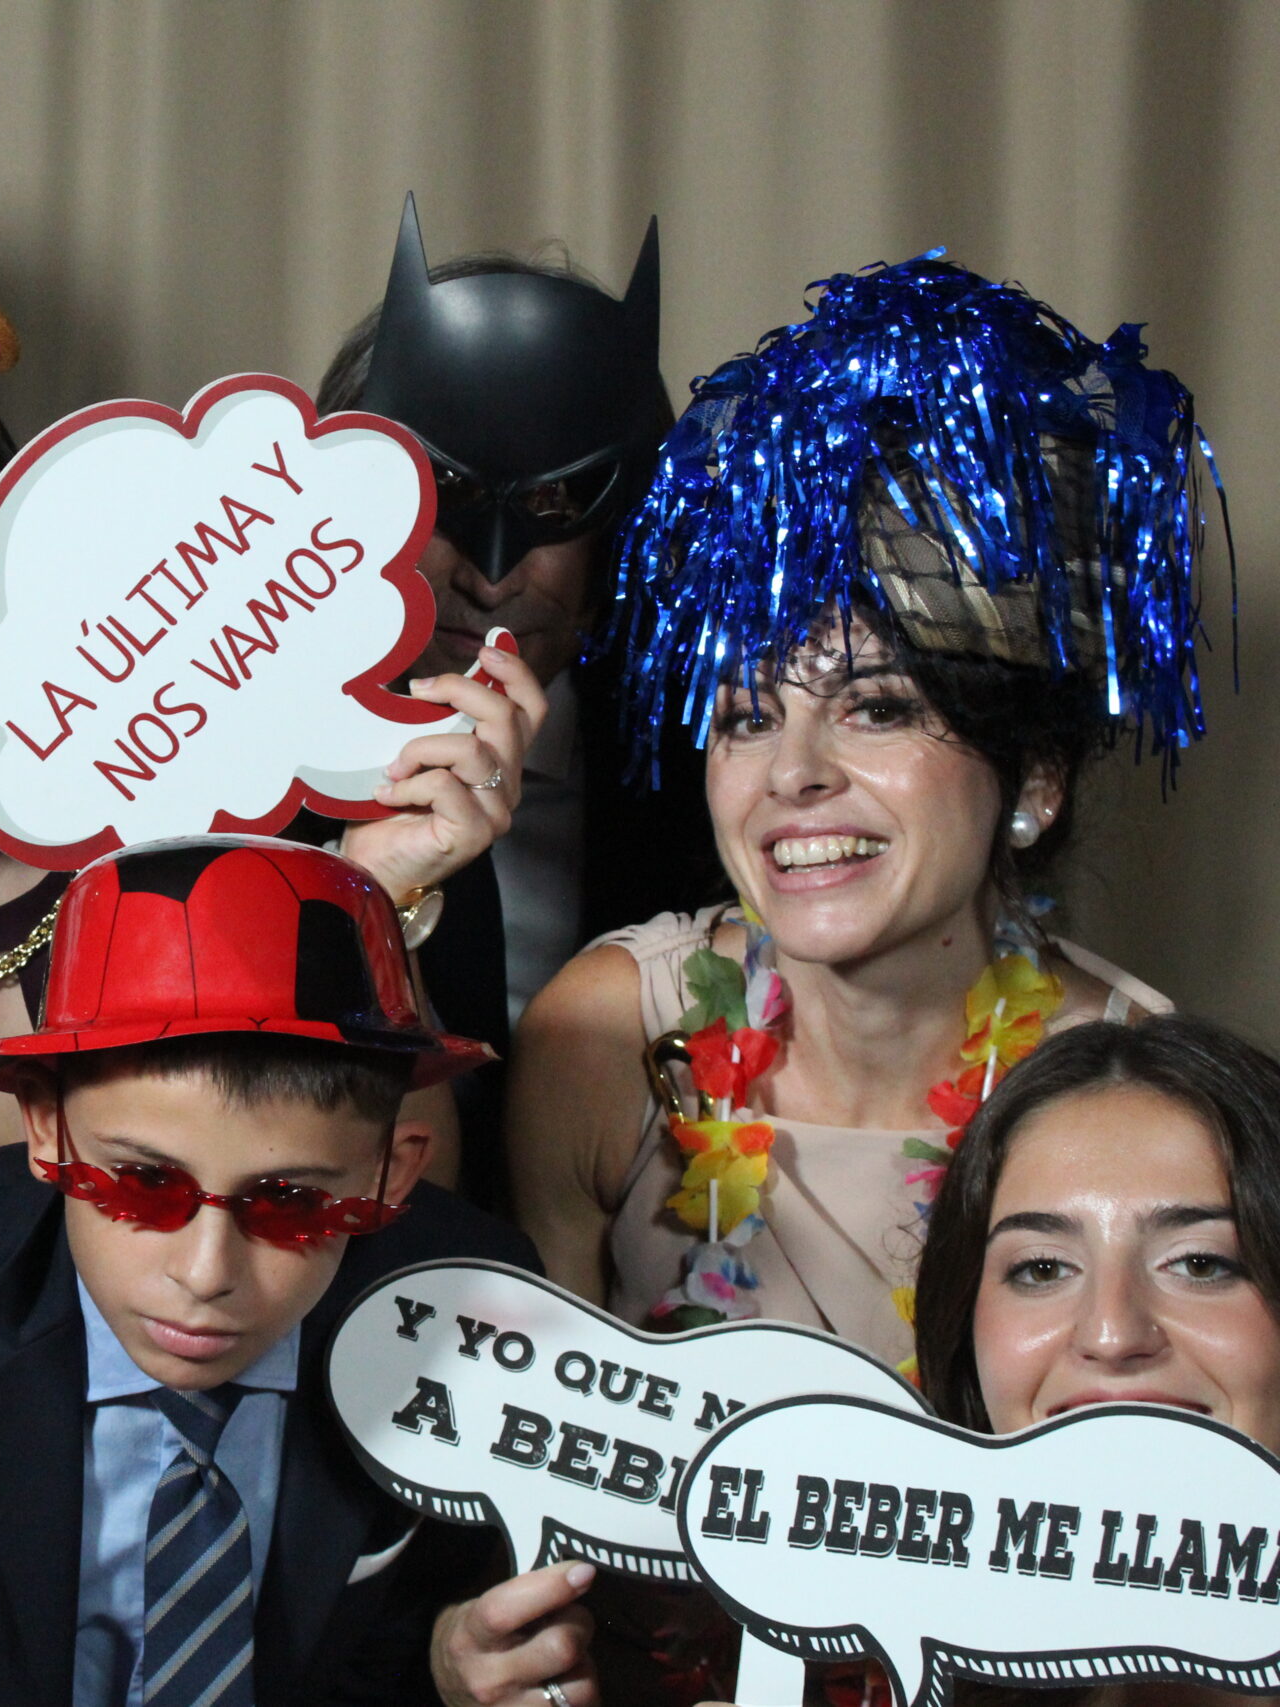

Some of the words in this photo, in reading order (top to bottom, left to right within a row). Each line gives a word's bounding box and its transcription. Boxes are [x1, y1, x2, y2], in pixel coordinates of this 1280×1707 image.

[5, 680, 98, 762] LA
[75, 495, 275, 684] ÚLTIMA
[251, 441, 303, 495] Y
[92, 681, 208, 802] NOS
[190, 517, 365, 691] VAMOS
[390, 1375, 460, 1448] A
[393, 1294, 438, 1344] Y
[454, 1313, 536, 1373] YO
[554, 1350, 681, 1422] QUE
[700, 1464, 772, 1545] EL
[787, 1474, 975, 1567] BEBER
[988, 1497, 1082, 1581] ME
